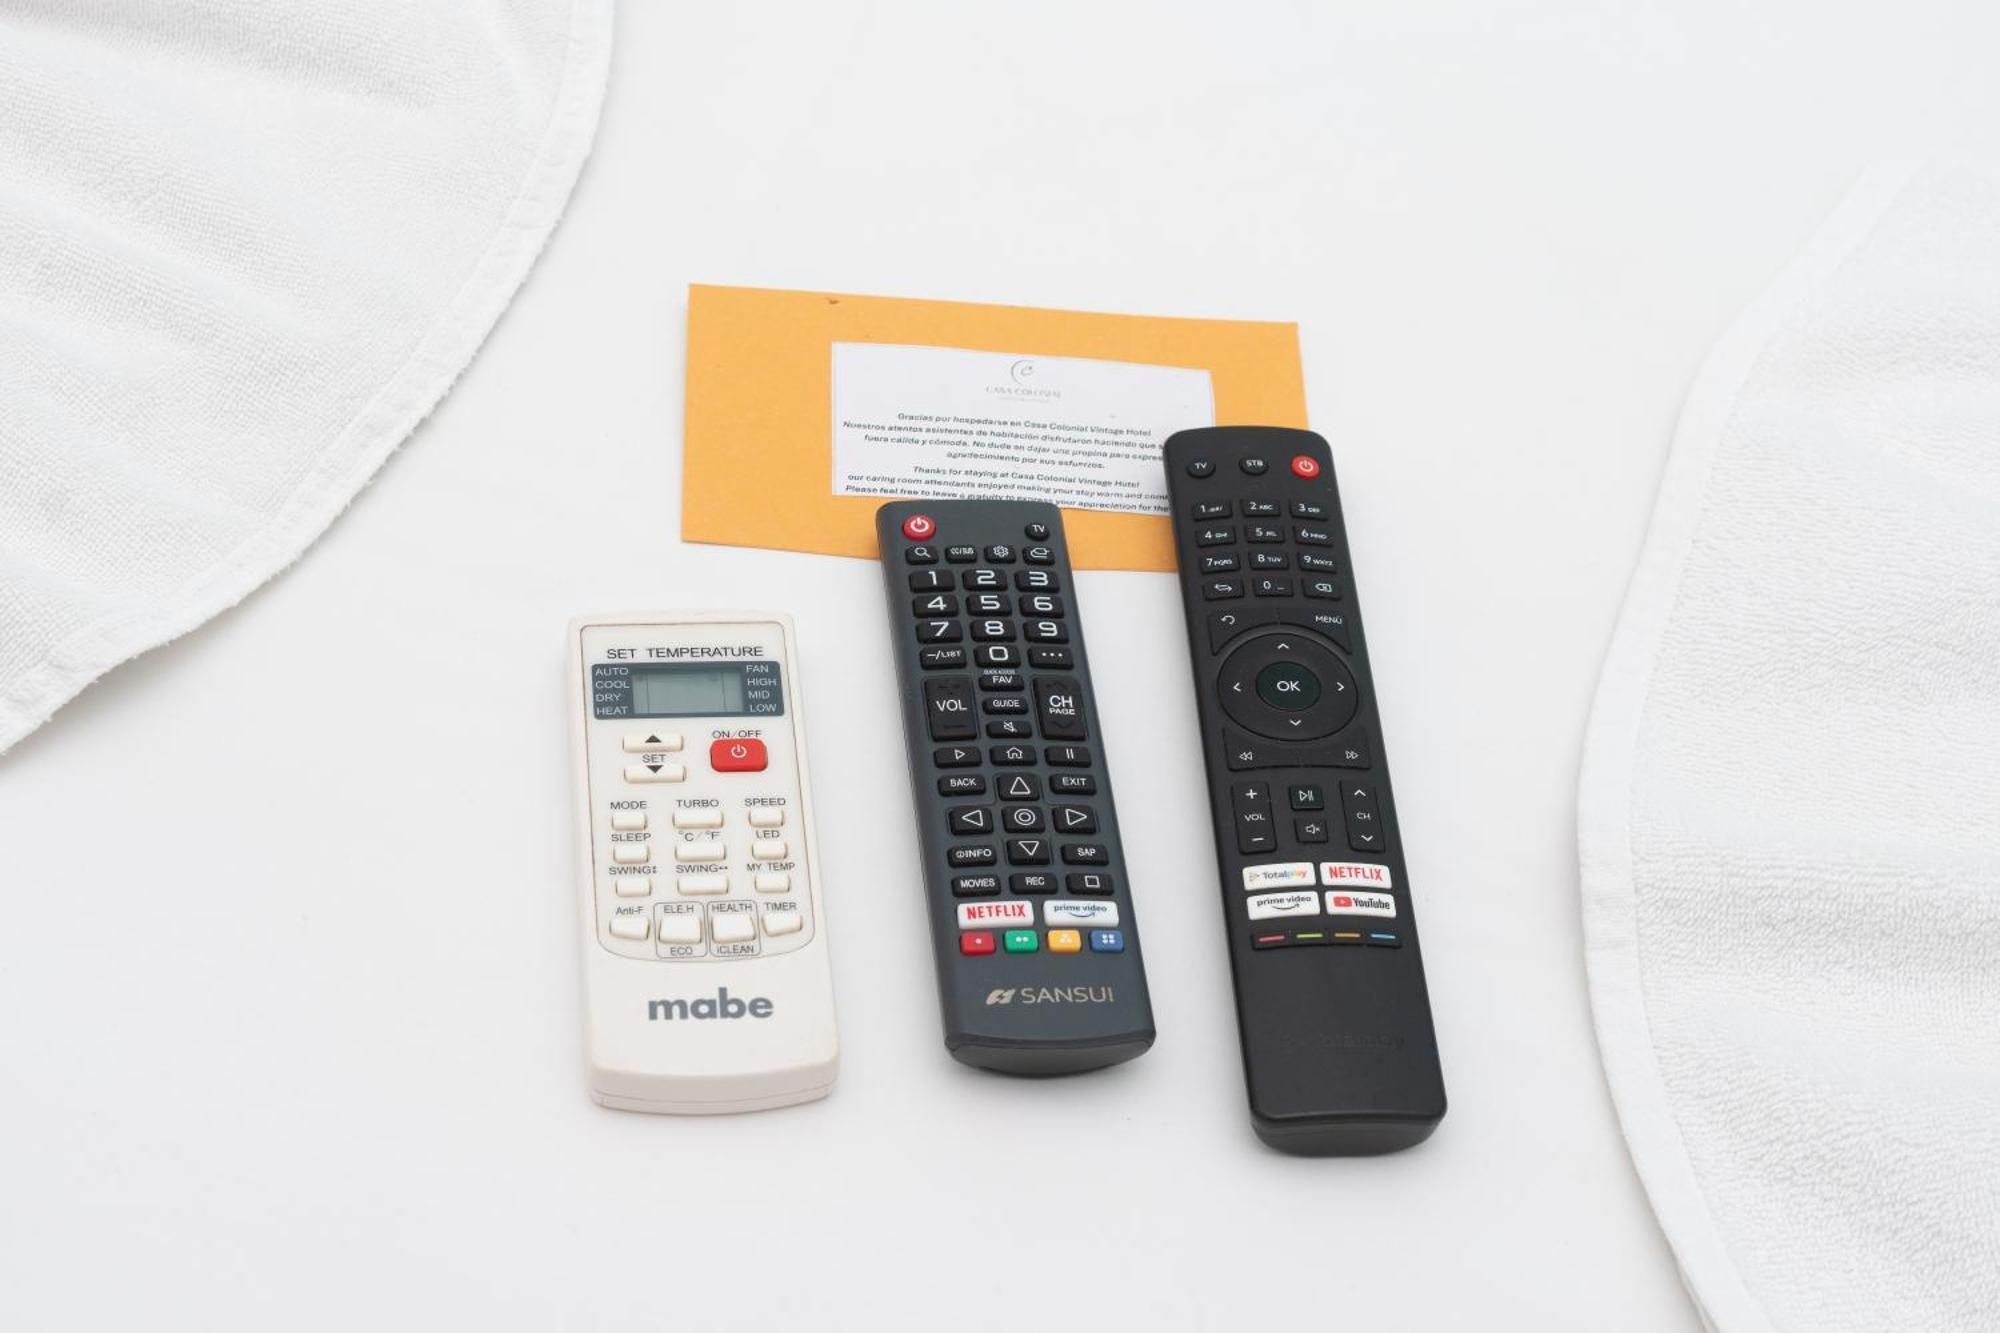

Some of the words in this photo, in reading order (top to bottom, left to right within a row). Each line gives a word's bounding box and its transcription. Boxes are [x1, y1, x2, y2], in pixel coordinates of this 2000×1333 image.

[898, 412, 933, 420] Gracias
[953, 416, 1008, 425] hospedarse
[1024, 420, 1048, 428] Casa
[1049, 423, 1088, 432] Colonial
[1090, 426, 1124, 436] Vintage
[843, 421, 886, 431] Nuestros
[924, 427, 974, 436] asistentes
[990, 430, 1039, 440] habitación
[1041, 435, 1092, 445] disfrutaron
[1094, 438, 1137, 448] haciendo
[1139, 442, 1156, 450] que
[864, 434, 888, 442] fuera
[972, 440, 986, 448] No
[988, 441, 1012, 450] dude
[1026, 444, 1050, 454] dejar
[1053, 448, 1070, 456] una
[1072, 450, 1108, 458] propina
[1109, 452, 1130, 460] para
[946, 452, 1020, 462] agradecimiento
[1022, 456, 1038, 464] por
[1058, 460, 1105, 469] esfuerzos.
[1195, 462, 1208, 470] TV
[913, 465, 946, 475] Thanks
[948, 468, 962, 476] for
[964, 469, 998, 478] staying
[1012, 472, 1034, 480] Casa
[1036, 474, 1076, 484] Colonial
[1078, 477, 1112, 487] Vintage
[1114, 480, 1140, 488] Hotel
[866, 475, 896, 484] caring
[898, 478, 922, 486] room
[924, 480, 976, 489] attendants
[977, 482, 1016, 491] enjoyed
[1017, 484, 1052, 494] making
[1053, 487, 1073, 496] your
[1076, 490, 1096, 498] stay
[846, 484, 878, 494] Please
[900, 488, 919, 496] free
[932, 490, 958, 498] leave
[1078, 500, 1137, 510] appreciation
[1138, 504, 1152, 512] for
[1250, 502, 1256, 510] 2
[1299, 504, 1306, 512] 3
[1032, 524, 1045, 532] TV
[1256, 528, 1262, 536] 5
[1302, 528, 1308, 537] 6
[1204, 530, 1212, 539] 4
[1206, 558, 1213, 566] 7
[1258, 554, 1264, 563] 8
[1304, 556, 1312, 564] 9
[928, 571, 938, 585] 1
[976, 570, 997, 584] 2
[1028, 572, 1048, 586] 3
[1264, 580, 1271, 590] 0
[927, 596, 947, 610] 4
[980, 595, 1000, 610] 5
[1034, 597, 1054, 610] 6
[930, 622, 949, 636] 7
[984, 621, 1004, 636] 8
[1038, 622, 1058, 636] 9
[607, 648, 637, 659] SET
[646, 646, 764, 659] TEMPERATURE
[988, 646, 1009, 661] 0
[595, 667, 629, 676] AUTO
[746, 664, 769, 674] FAN
[595, 680, 630, 689] COOL
[747, 678, 777, 687] HIGH
[992, 676, 1012, 684] FAV
[1276, 680, 1300, 692] OK
[595, 693, 622, 702] DRY
[748, 690, 770, 700] MID
[936, 700, 968, 712] VOL
[992, 699, 1020, 708] GUIDE
[1050, 695, 1073, 708] CH
[596, 706, 628, 716] HEAT
[750, 704, 777, 713] LOW
[1050, 708, 1076, 716] PAGE
[642, 754, 666, 763] SET
[950, 778, 977, 788] BACK
[1062, 777, 1086, 786] EXIT
[610, 800, 648, 810] MODE
[675, 800, 720, 808] TURBO
[744, 798, 786, 807] SPEED
[1244, 813, 1265, 822] VOL
[1356, 812, 1371, 820] CH
[611, 832, 652, 842] SLEEP
[755, 830, 780, 840] LED
[1078, 848, 1096, 857] SAP
[746, 863, 762, 872] MY
[767, 862, 796, 872] TEMP
[1328, 866, 1383, 881] NETFLIX
[960, 878, 996, 888] MOVIES
[1025, 877, 1045, 886] REC
[1256, 897, 1284, 907] prime
[1286, 895, 1312, 904] video
[1352, 897, 1391, 910] YouTube
[615, 906, 644, 916] Anti-F
[664, 904, 694, 914] ELE.H
[712, 903, 753, 913] HEALTH
[764, 902, 797, 912] TIMER
[966, 904, 1026, 920] NETFLIX
[1054, 904, 1080, 913] prime
[1082, 904, 1108, 912] video
[670, 946, 693, 956] ECO
[1020, 986, 1114, 1004] SANSUI
[648, 986, 774, 1021] mabe
